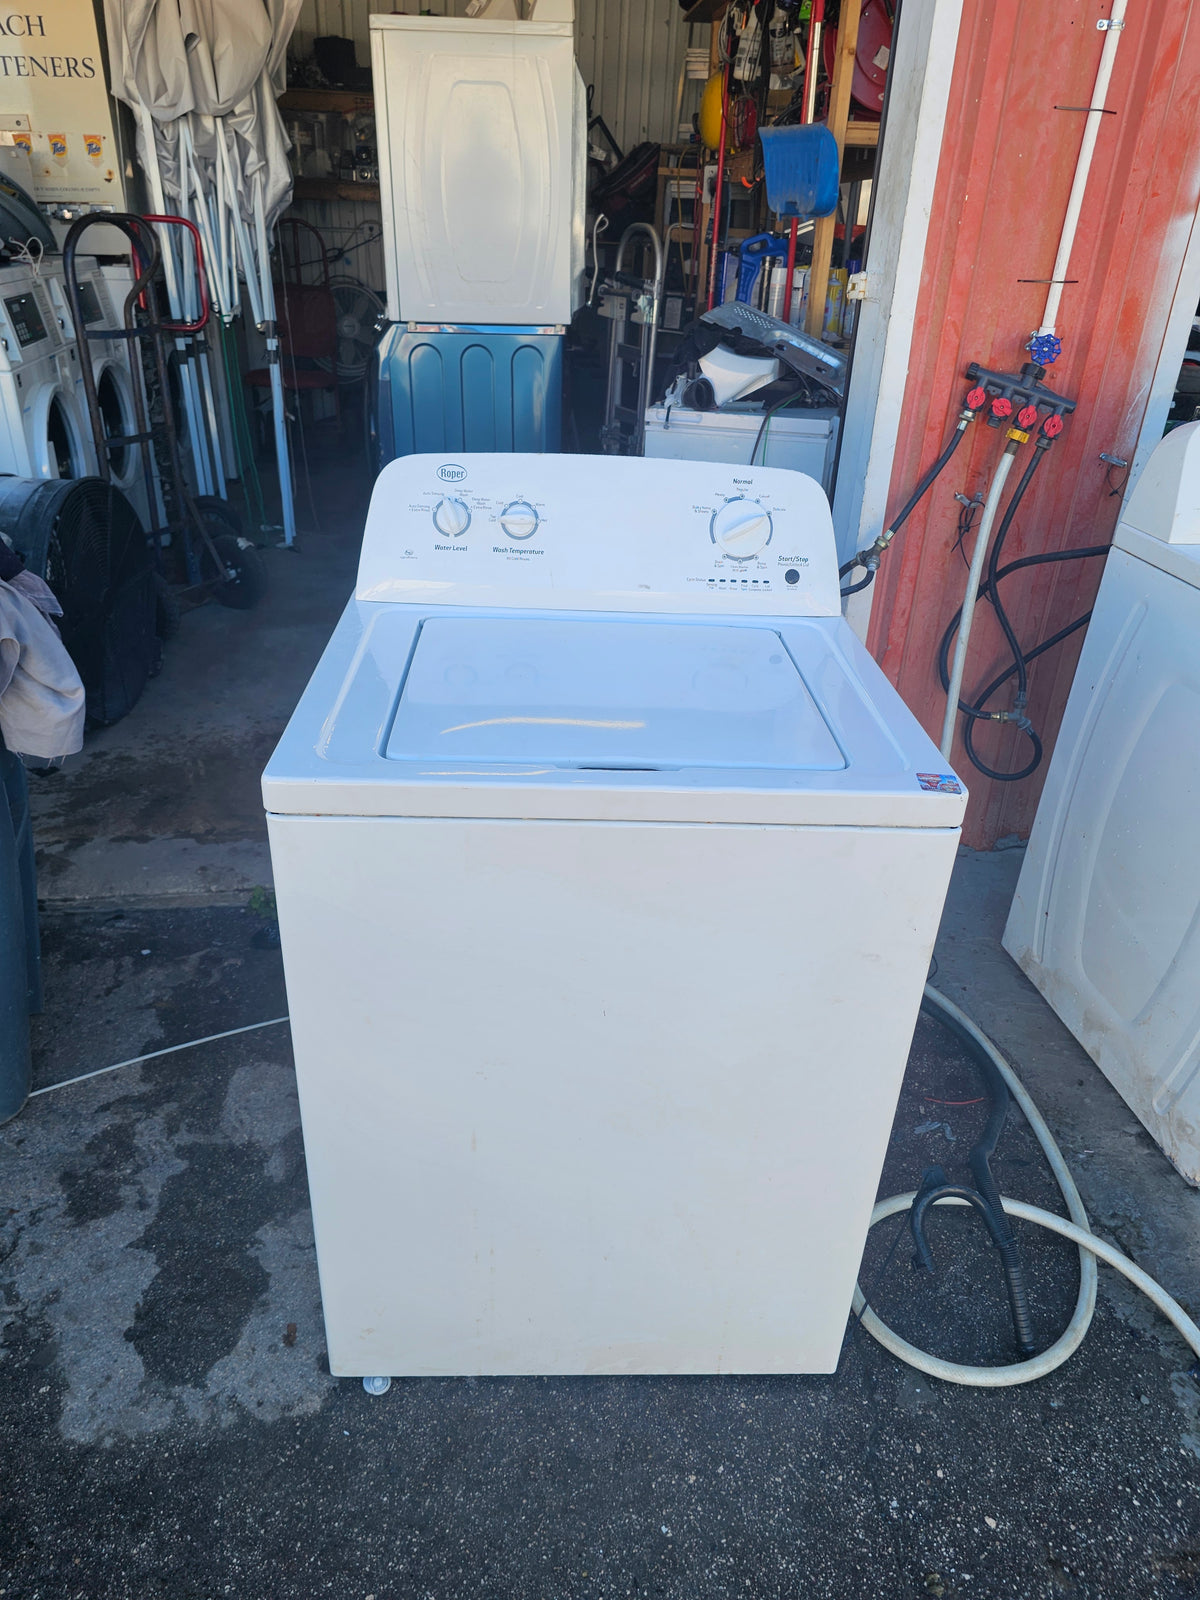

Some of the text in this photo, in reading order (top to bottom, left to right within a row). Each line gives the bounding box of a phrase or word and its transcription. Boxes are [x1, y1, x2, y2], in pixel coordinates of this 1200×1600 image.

[51, 142, 66, 156] Tide
[86, 143, 101, 156] Tide
[440, 468, 464, 479] Roper
